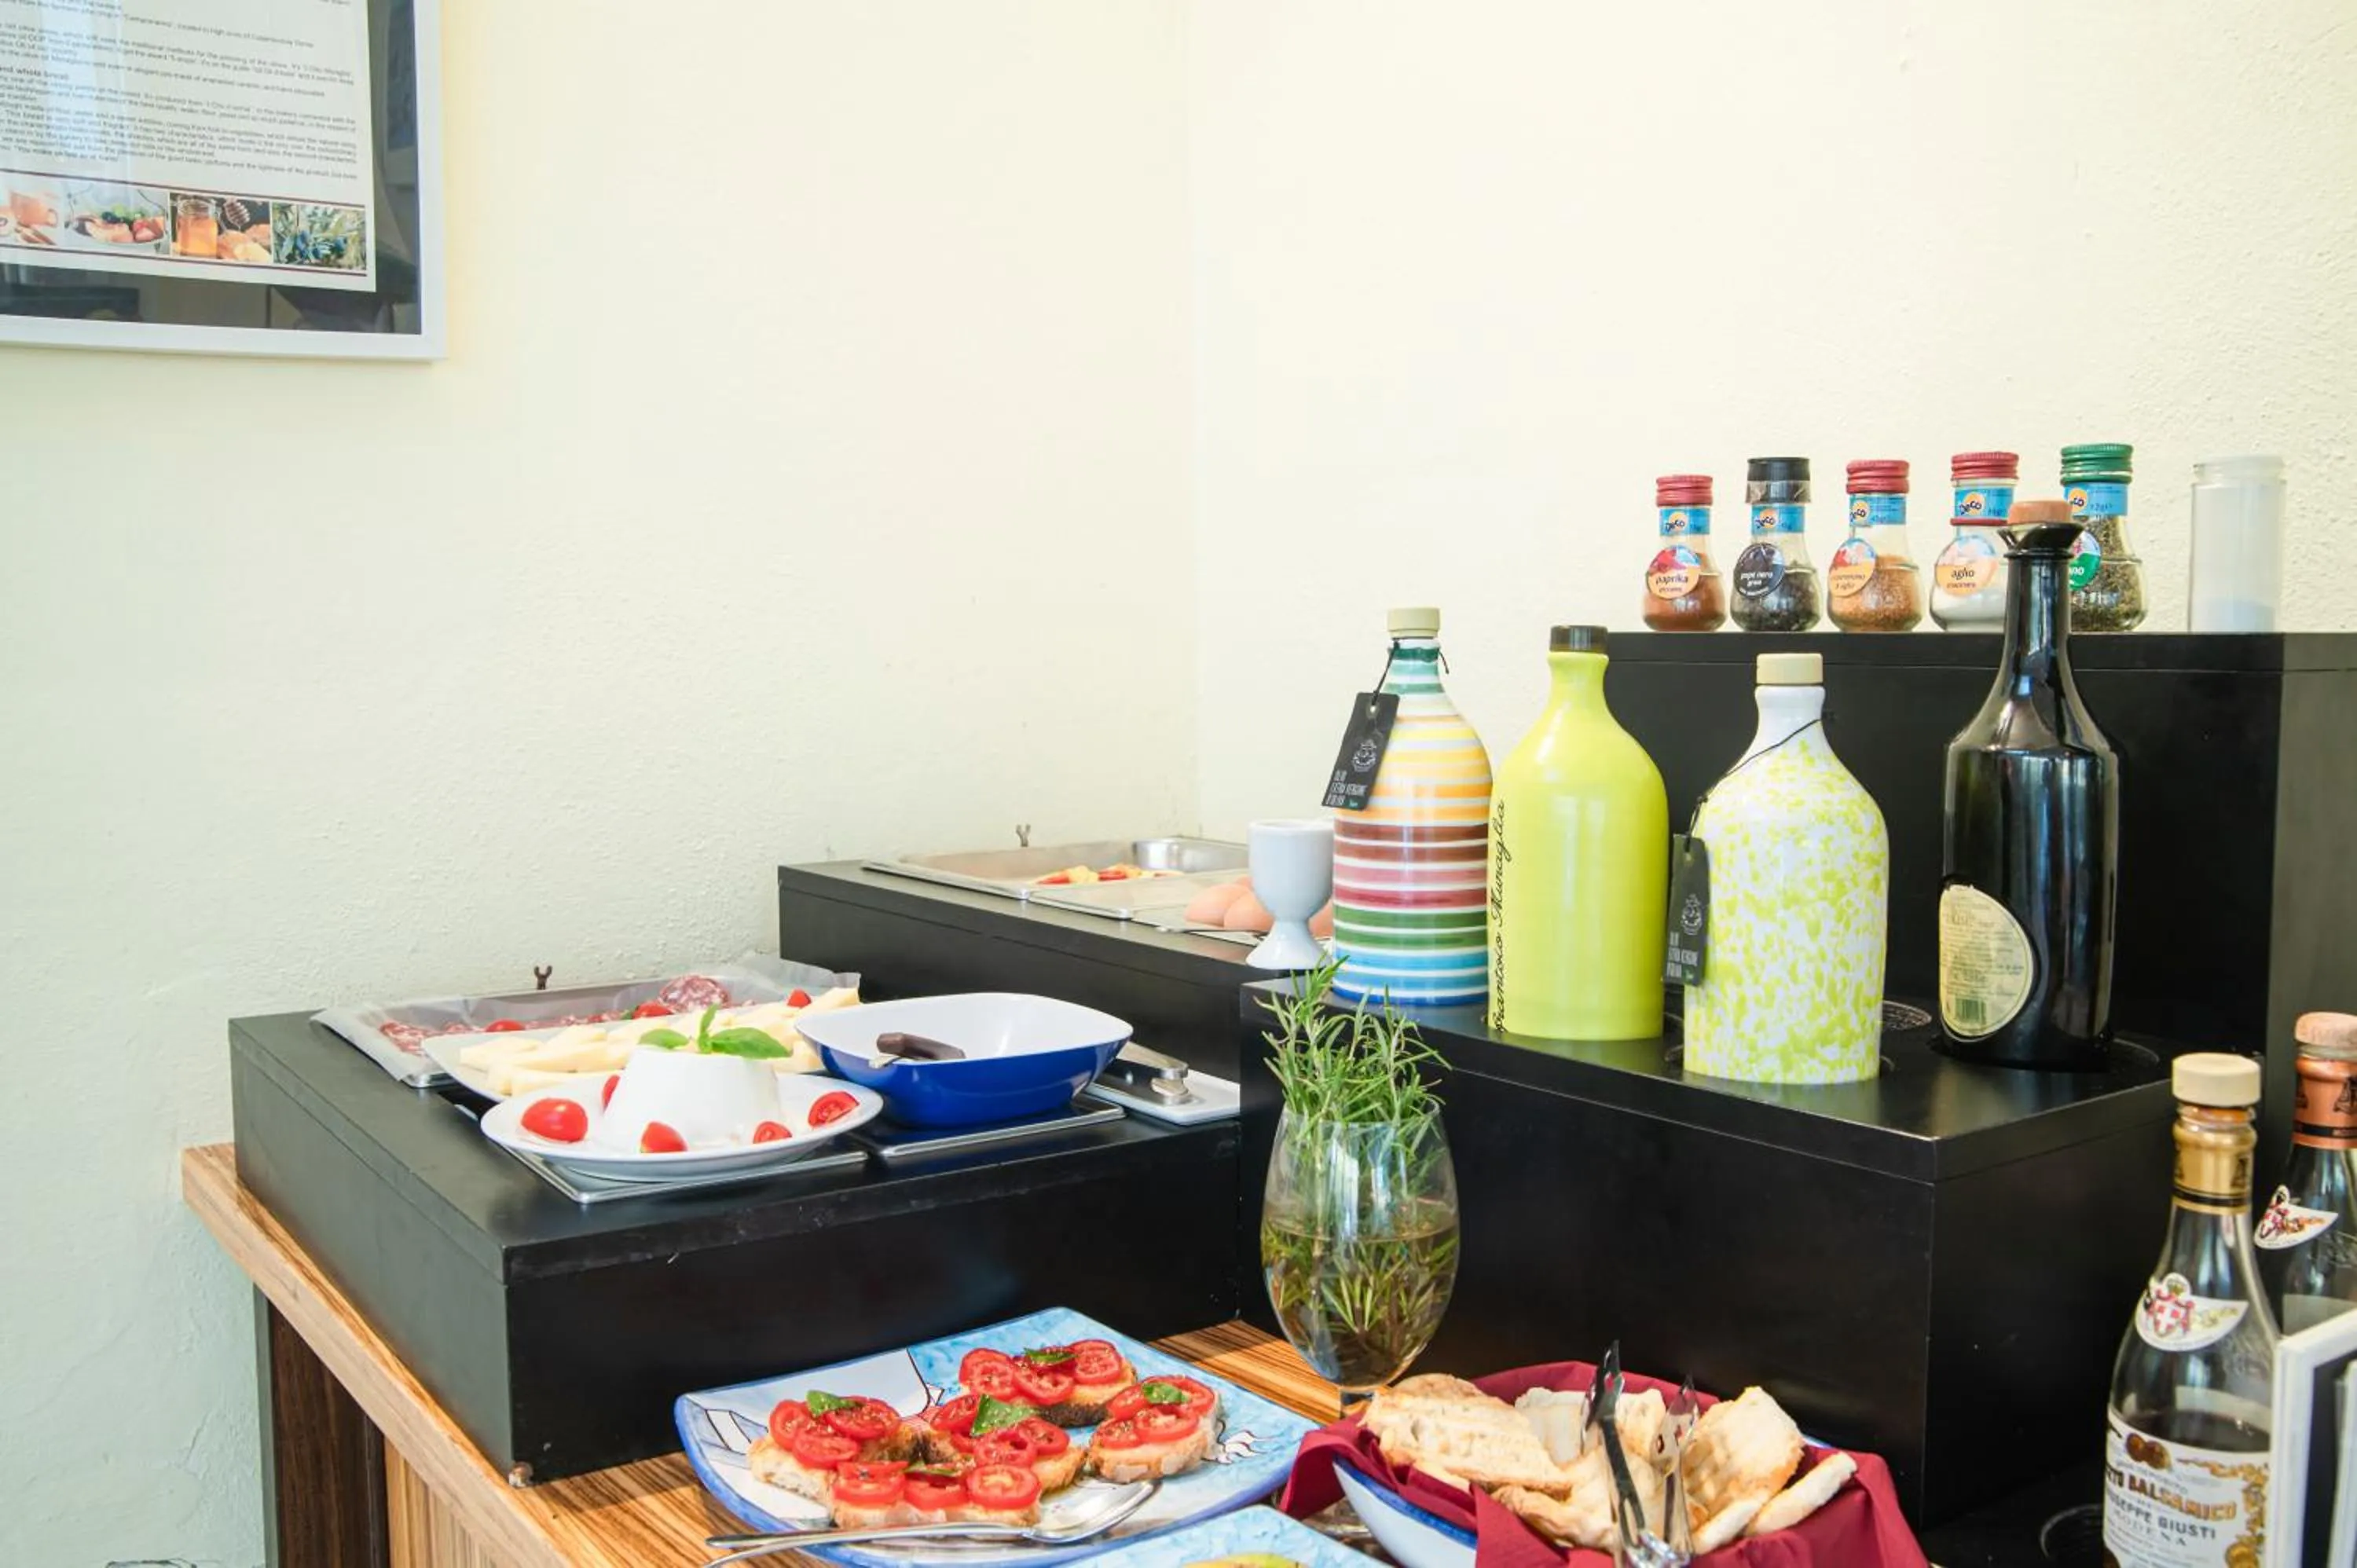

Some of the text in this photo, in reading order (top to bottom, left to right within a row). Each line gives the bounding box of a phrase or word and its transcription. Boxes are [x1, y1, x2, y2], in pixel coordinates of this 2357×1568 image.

[1655, 573, 1689, 585] paprika
[1490, 799, 1512, 928] Muraglia
[2128, 1474, 2238, 1521] BALSAMICO
[2157, 1515, 2217, 1540] GIUSTI
